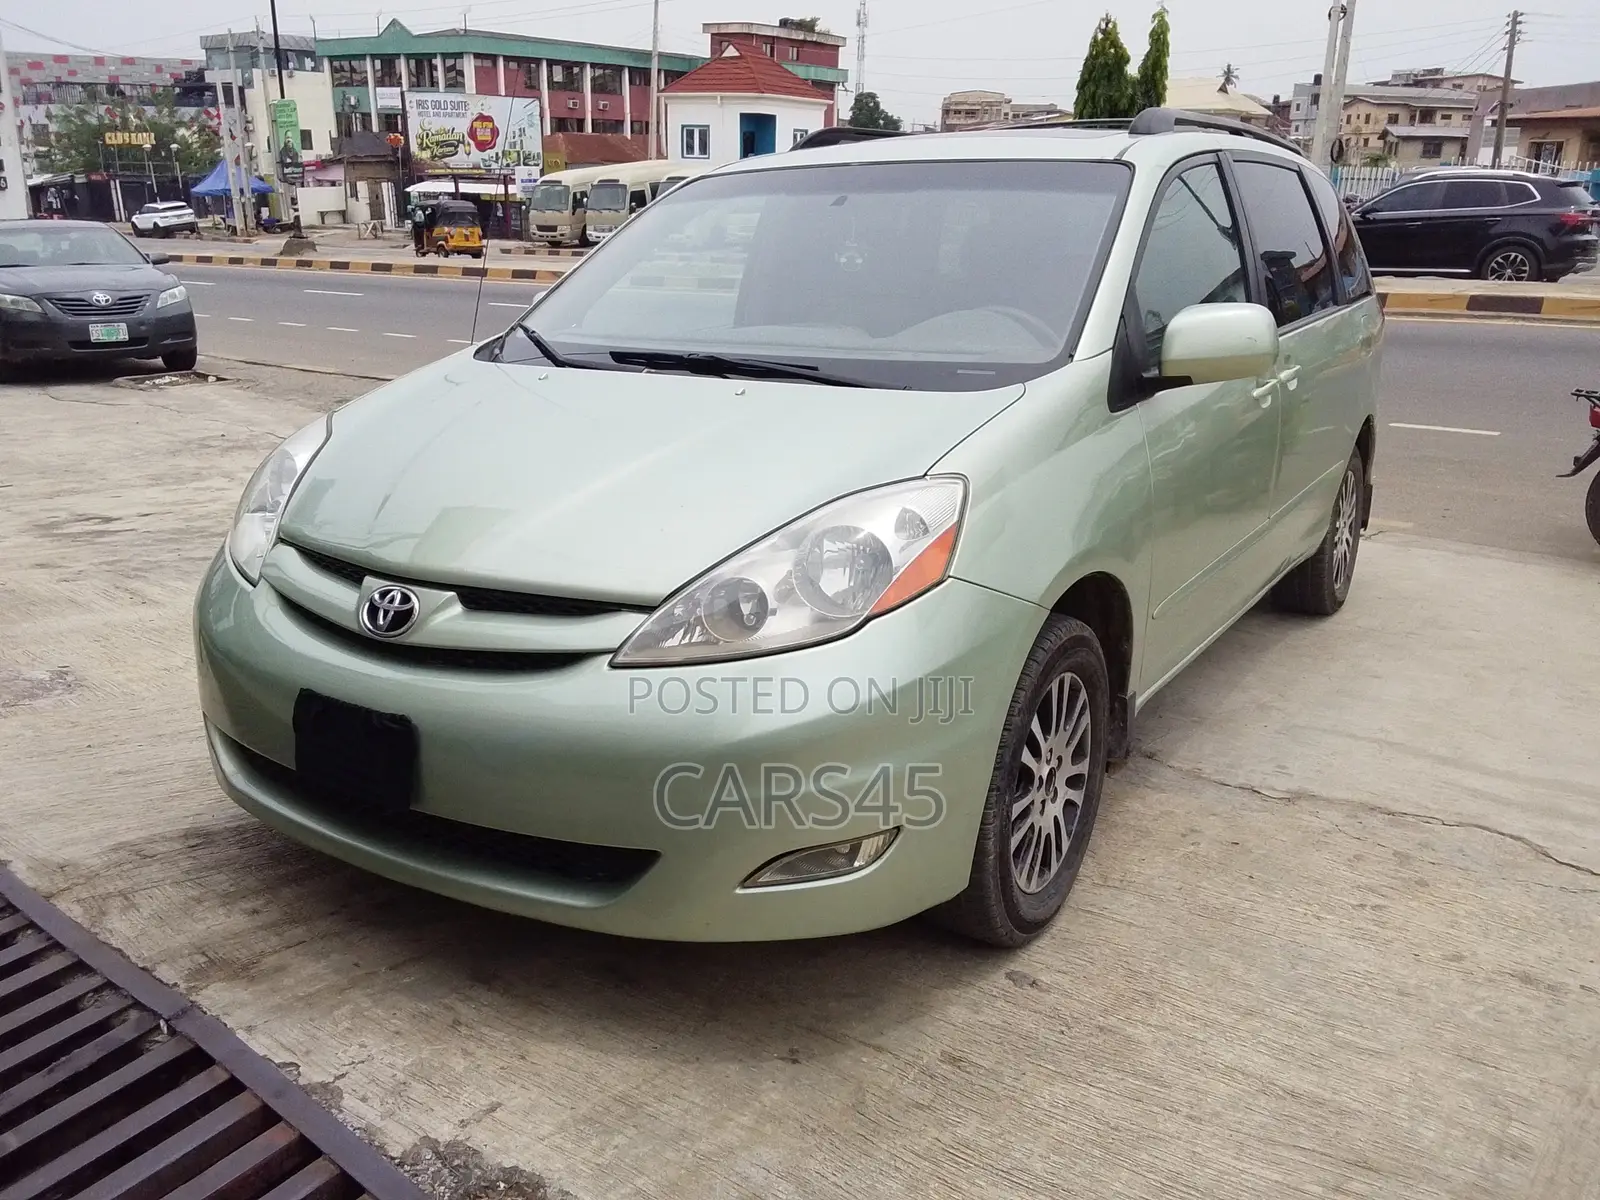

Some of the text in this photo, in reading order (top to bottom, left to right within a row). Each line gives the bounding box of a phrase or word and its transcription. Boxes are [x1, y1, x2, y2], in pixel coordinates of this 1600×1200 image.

[416, 99, 430, 110] IRIS
[431, 99, 449, 111] GOLD
[419, 127, 464, 148] Ramadan
